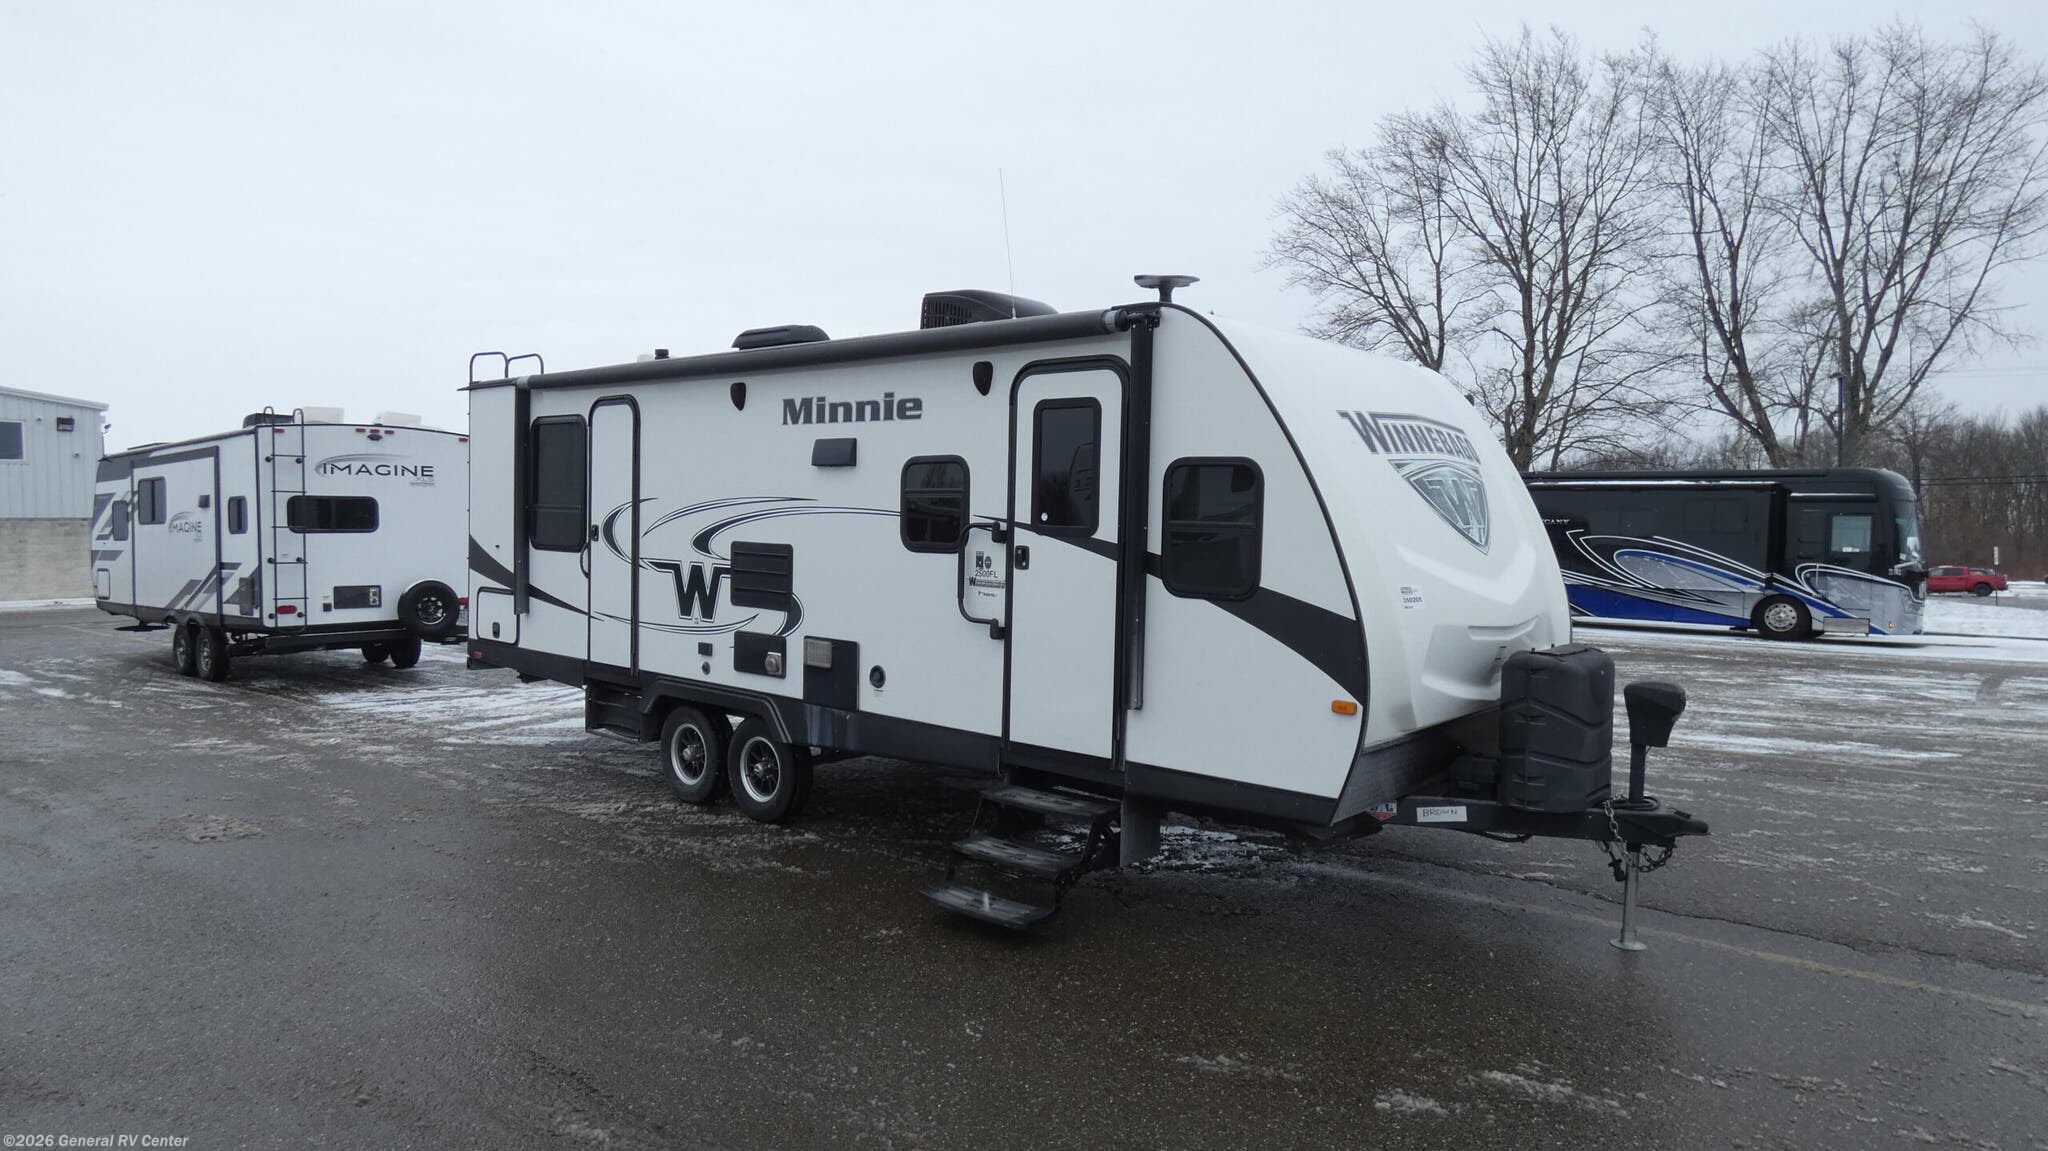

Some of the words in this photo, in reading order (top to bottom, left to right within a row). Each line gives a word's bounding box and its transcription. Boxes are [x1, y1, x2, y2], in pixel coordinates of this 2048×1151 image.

[782, 391, 923, 426] Minnie
[323, 462, 434, 478] IMAGINE
[640, 558, 732, 623] W
